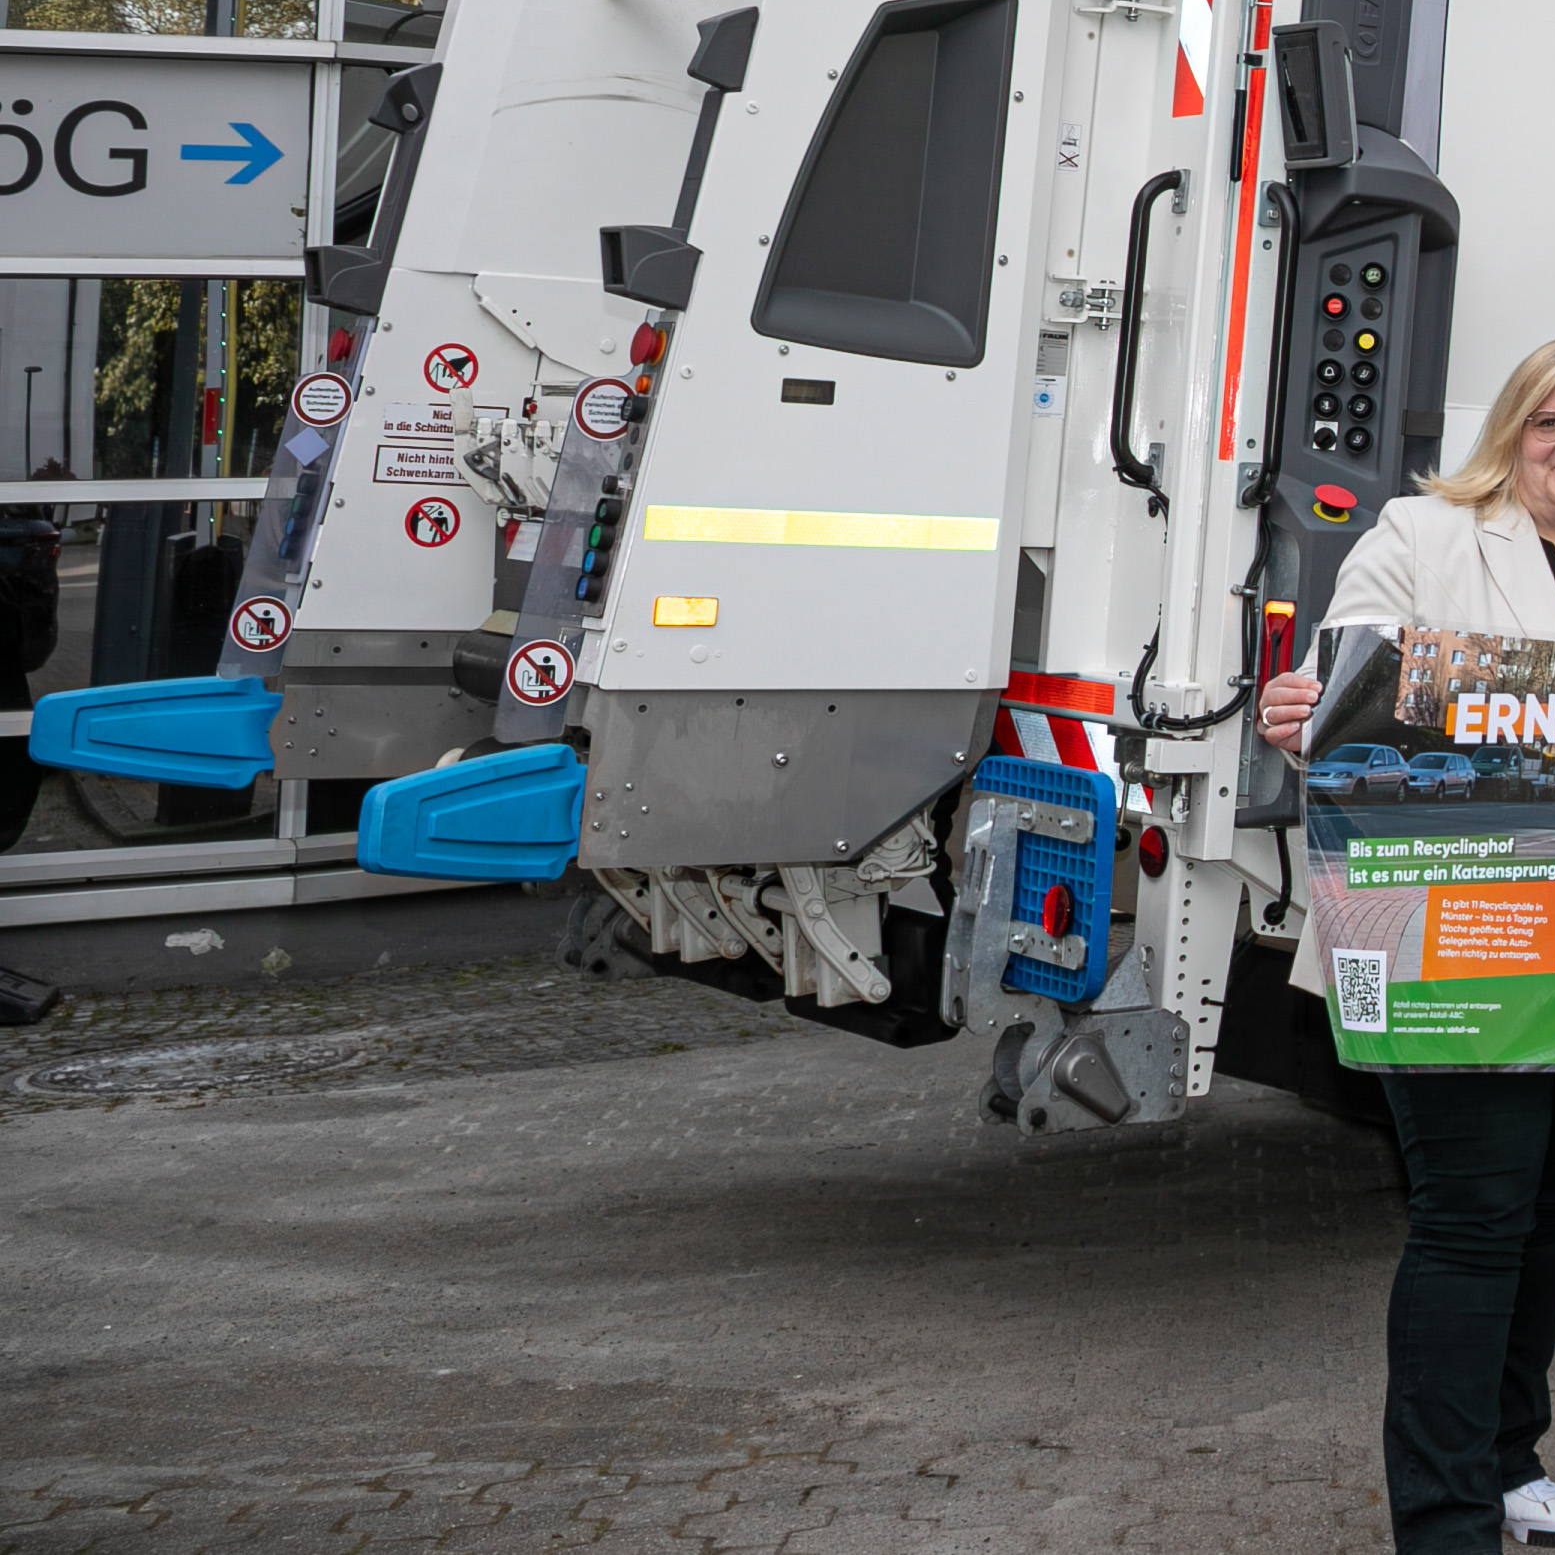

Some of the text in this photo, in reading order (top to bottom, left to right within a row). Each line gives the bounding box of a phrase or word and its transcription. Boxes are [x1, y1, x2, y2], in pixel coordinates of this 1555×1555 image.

[396, 421, 412, 431] die
[397, 452, 425, 464] Nicht
[386, 466, 455, 480] Schwenkarm
[1349, 837, 1515, 859] Bis zum Recyclinghof
[1349, 868, 1368, 884] ist
[1371, 870, 1389, 884] es
[1393, 869, 1420, 883] nur
[1423, 865, 1448, 882] ein
[1442, 899, 1452, 908] Es
[1453, 899, 1470, 911] gibt
[1479, 900, 1534, 911] Recyclinghöfe
[1535, 902, 1543, 911] in
[1441, 911, 1473, 921] Münster
[1482, 913, 1495, 922] bis
[1496, 914, 1506, 923] zu
[1513, 914, 1533, 925] Tage
[1534, 916, 1548, 926] pro
[1440, 924, 1468, 933] Woche
[1507, 926, 1533, 937] Genug
[1492, 937, 1508, 946] alte
[1437, 948, 1460, 957] reifen
[1461, 949, 1487, 959] richtig
